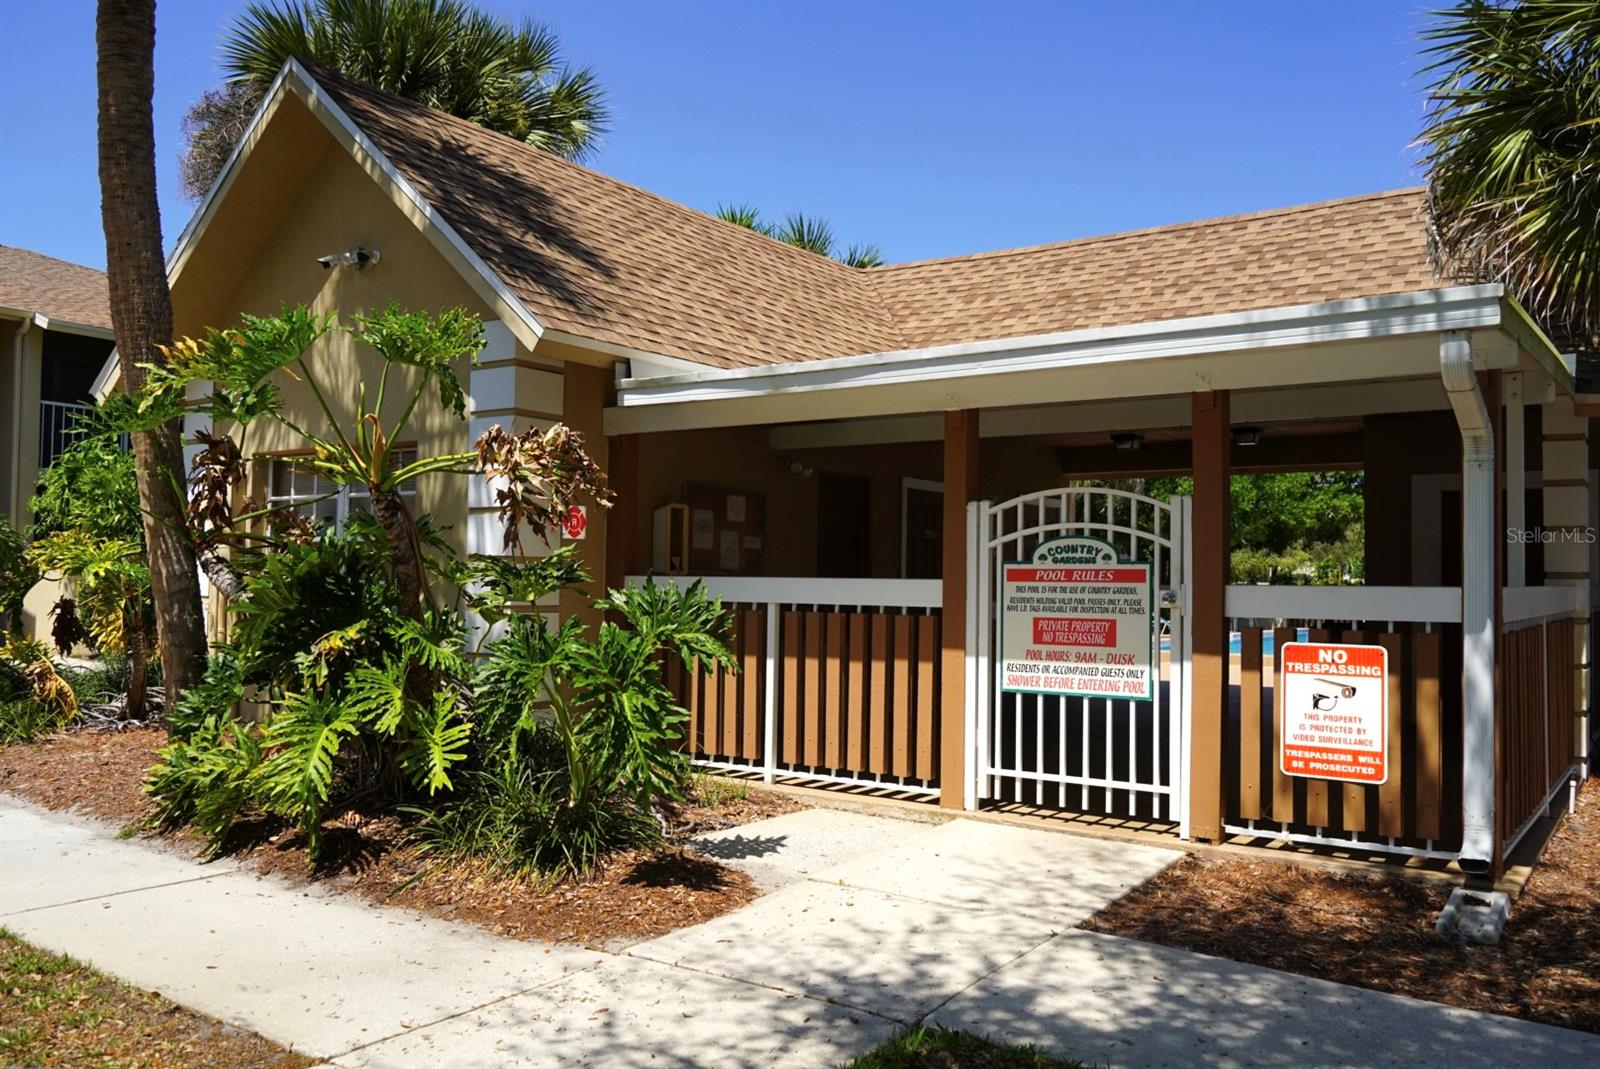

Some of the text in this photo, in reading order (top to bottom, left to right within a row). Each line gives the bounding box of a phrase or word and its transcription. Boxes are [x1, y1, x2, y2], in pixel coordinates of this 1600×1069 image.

[1047, 544, 1103, 557] COUNTRY
[1052, 556, 1097, 565] GARDENS
[1035, 570, 1114, 581] POOL RULES
[1113, 586, 1138, 595] GARDENS.
[1038, 620, 1110, 632] PRIVATE PROPERTY
[1042, 632, 1106, 645] NO TRESPASSING
[1025, 649, 1043, 660] POOL
[1046, 650, 1072, 662] HOURS:
[1075, 652, 1097, 663] 9AM
[1107, 653, 1135, 665] DUSK
[1319, 649, 1348, 664] NO
[1007, 663, 1145, 679] RESIDENTS OR ACCOMPANIED GUESTS ONLY
[1286, 662, 1382, 676] TRESPASSING
[1007, 674, 1145, 694] SHOWER BEFORE ENTERING POOL
[1324, 714, 1362, 724] PROPERTY
[1310, 724, 1353, 734] PROTECTED
[1318, 736, 1374, 747] SURVEILLANCE
[1286, 749, 1382, 764] TRESPASSERS WILL
[1310, 762, 1375, 774] PROSECUTED
